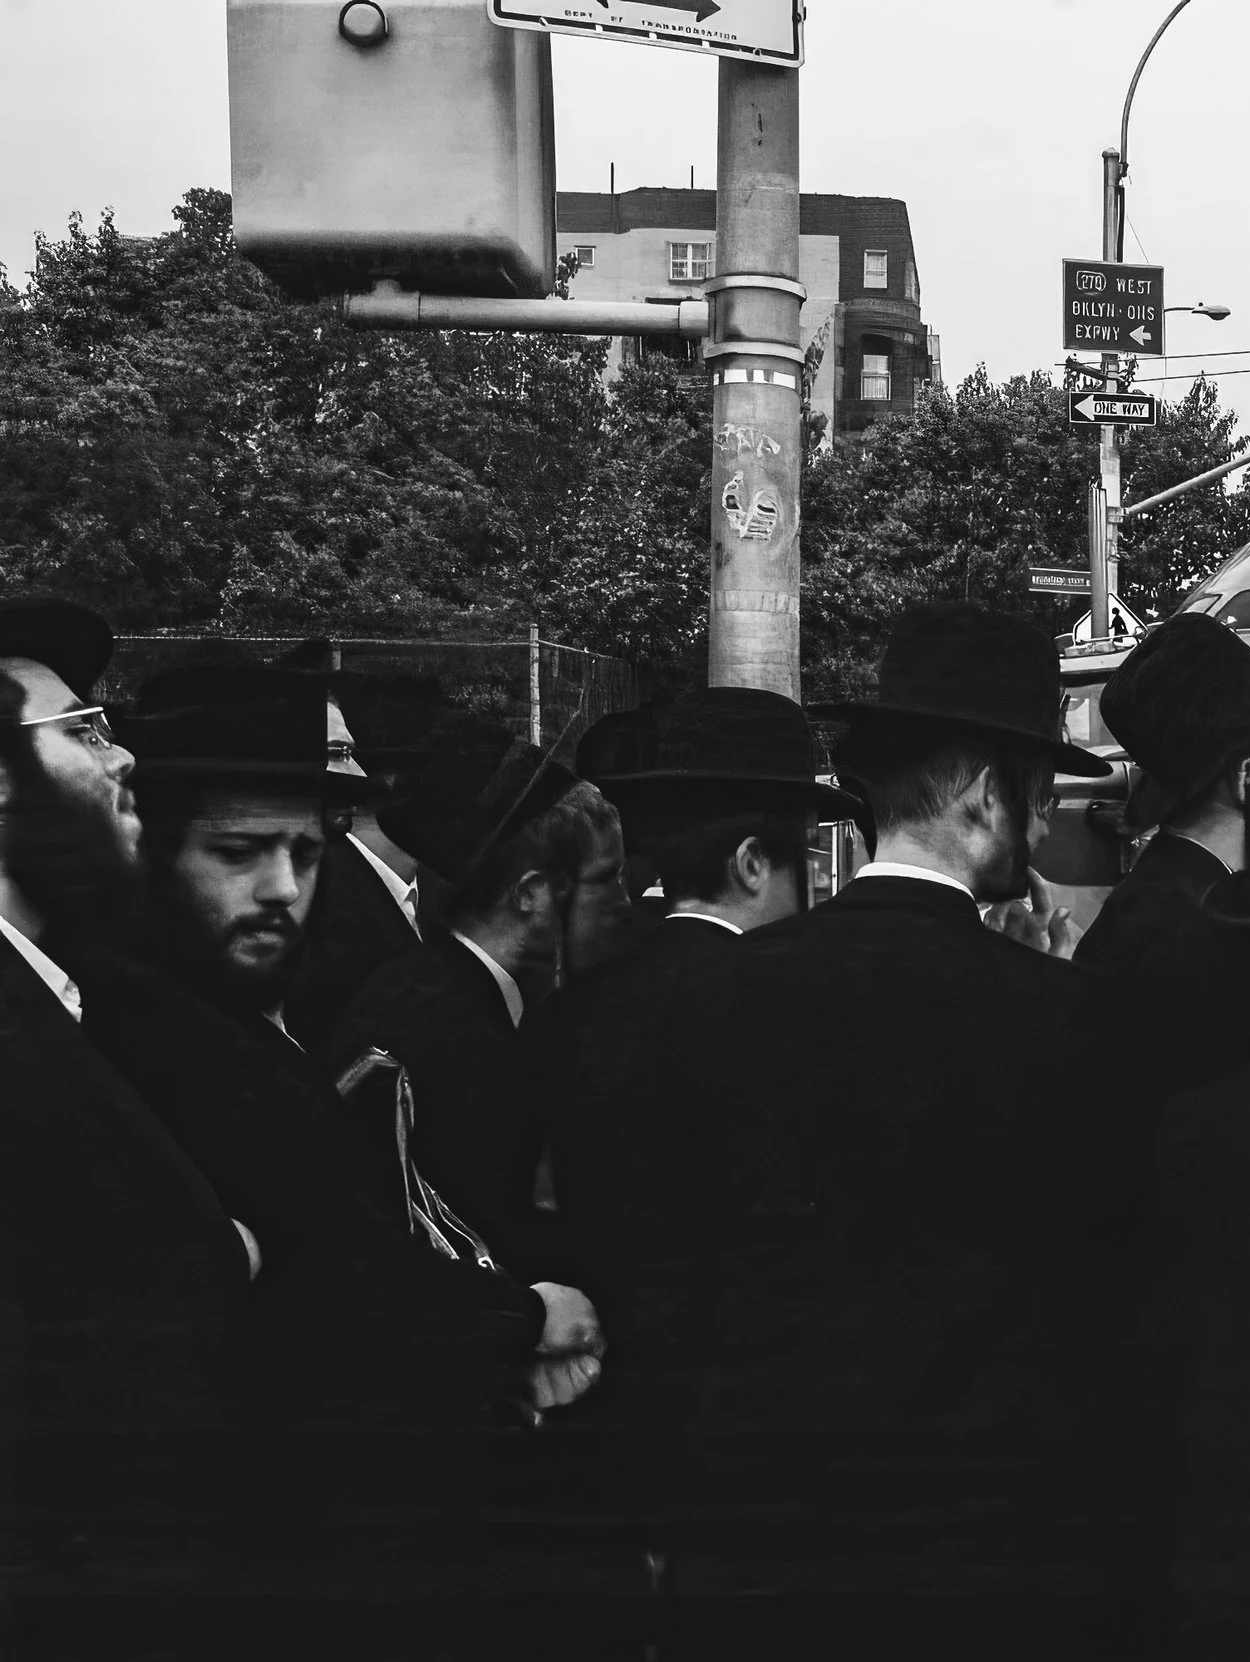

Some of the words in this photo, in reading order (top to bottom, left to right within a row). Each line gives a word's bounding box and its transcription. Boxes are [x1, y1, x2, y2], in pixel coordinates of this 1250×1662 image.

[1116, 278, 1152, 295] WEST
[1075, 323, 1120, 341] EXPWY
[1094, 402, 1118, 415] ONE
[1122, 403, 1145, 416] WAY
